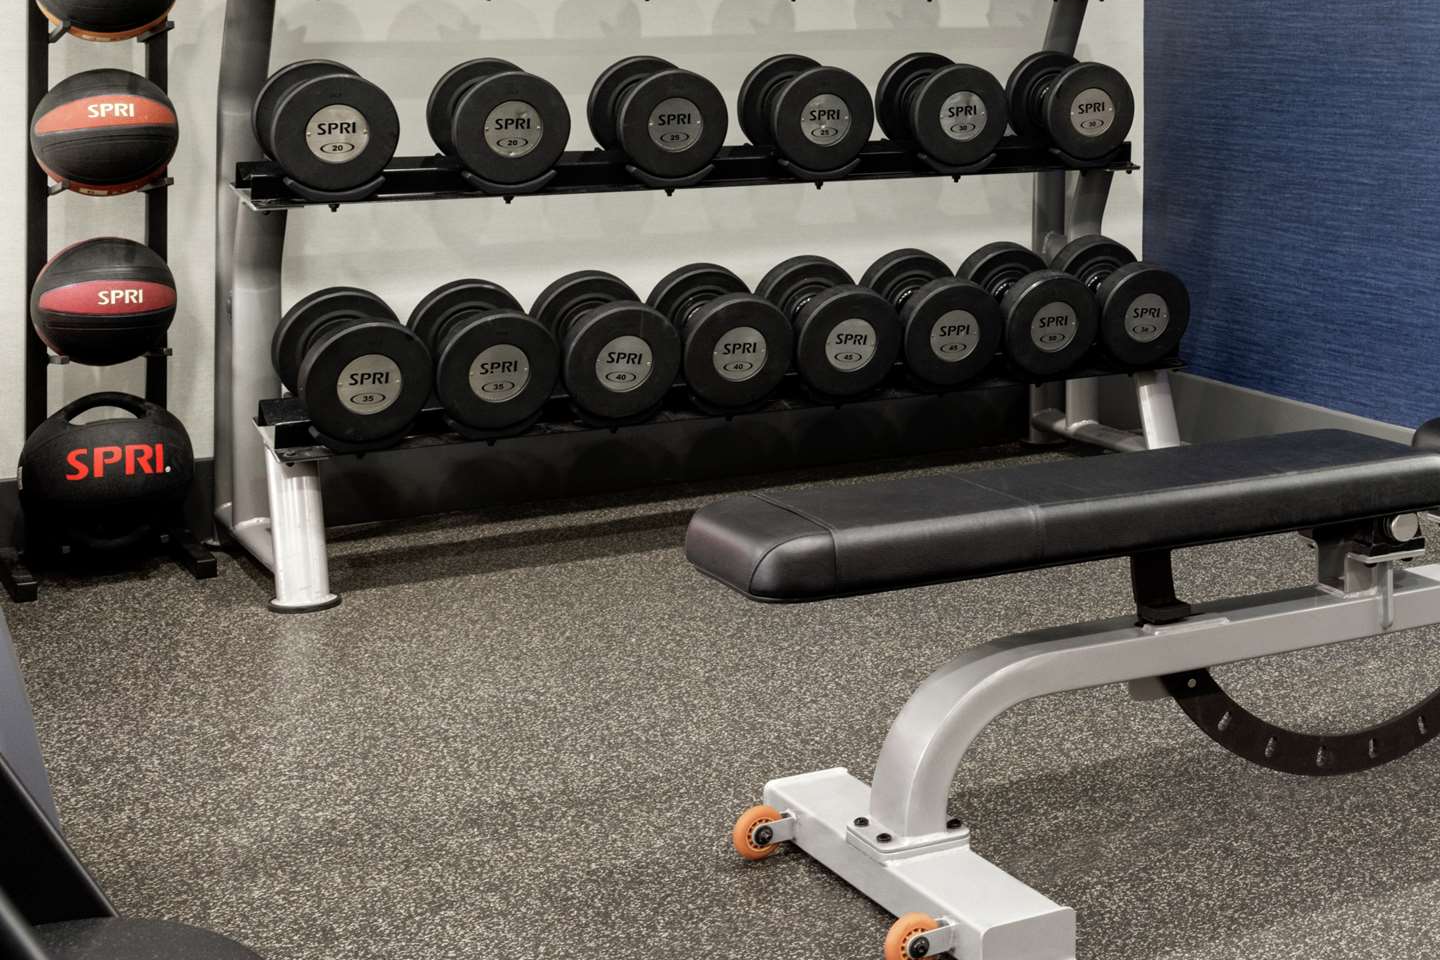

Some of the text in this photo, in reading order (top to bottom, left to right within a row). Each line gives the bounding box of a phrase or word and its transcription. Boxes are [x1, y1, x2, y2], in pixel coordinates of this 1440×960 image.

[88, 103, 135, 118] SPRI
[948, 104, 977, 118] SPRI
[1078, 102, 1105, 115] SPRI
[658, 113, 691, 127] SPRI
[809, 109, 840, 122] SPRI
[317, 121, 357, 136] SPRI
[495, 118, 531, 130] SPRI
[332, 144, 344, 152] 20
[98, 289, 143, 305] SPRI
[1132, 307, 1161, 319] SPRI
[1039, 315, 1068, 328] SPRI
[835, 333, 868, 346] SPRI
[722, 342, 757, 355] SPRI
[606, 351, 643, 365] SPRI
[479, 360, 518, 375] SPRI
[348, 371, 389, 386] SPRI
[615, 373, 627, 381] 40
